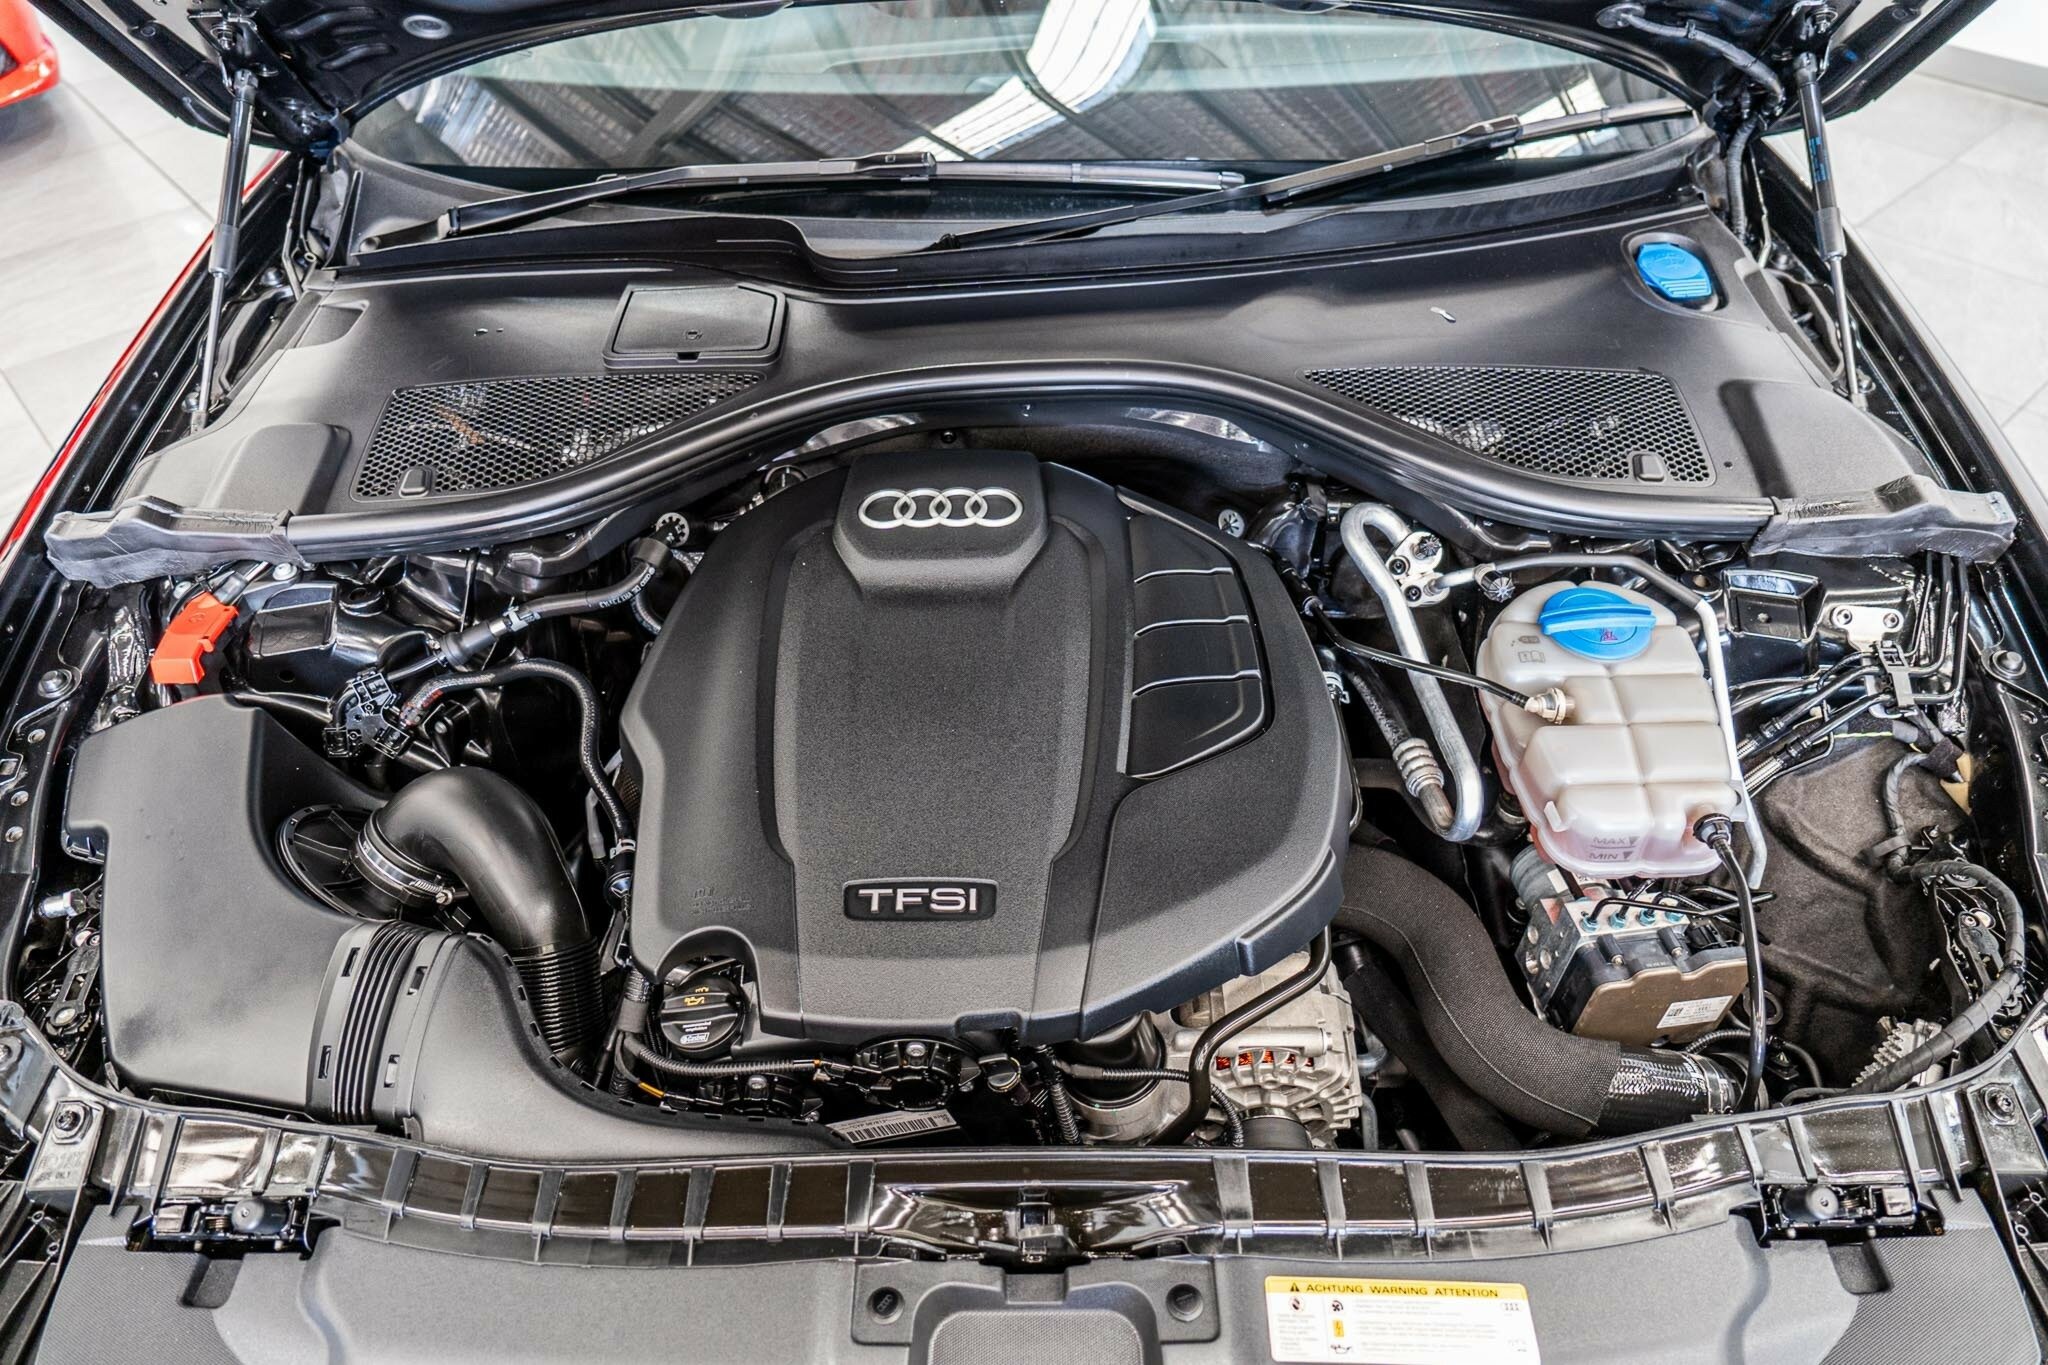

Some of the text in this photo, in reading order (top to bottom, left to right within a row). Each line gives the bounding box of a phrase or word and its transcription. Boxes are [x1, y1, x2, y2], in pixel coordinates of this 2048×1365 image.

[1593, 836, 1627, 845] MAX
[1589, 852, 1618, 860] MIN
[858, 887, 977, 913] TFSI
[1306, 1284, 1499, 1297] ACHTUNG WARNING ATTENTION
